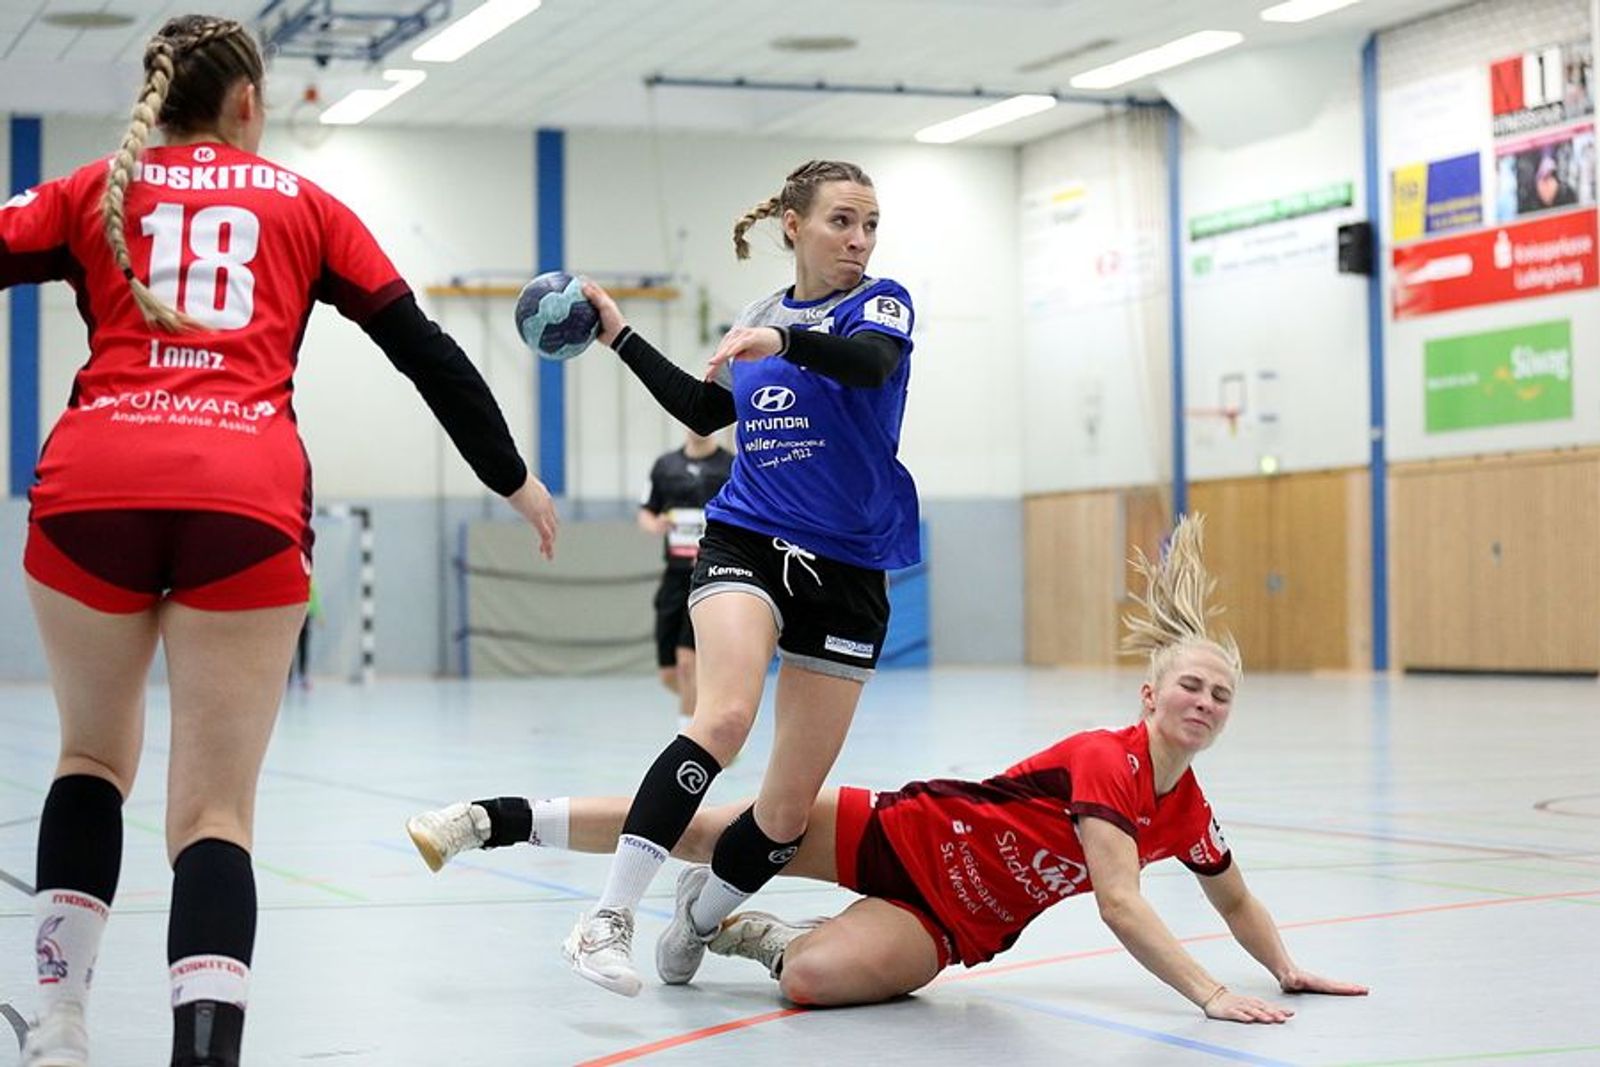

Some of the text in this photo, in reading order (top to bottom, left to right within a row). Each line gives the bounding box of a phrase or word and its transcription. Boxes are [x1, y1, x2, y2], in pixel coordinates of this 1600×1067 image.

[141, 202, 260, 331] 18
[744, 416, 810, 432] HYUNDAI
[707, 564, 754, 578] Kempa
